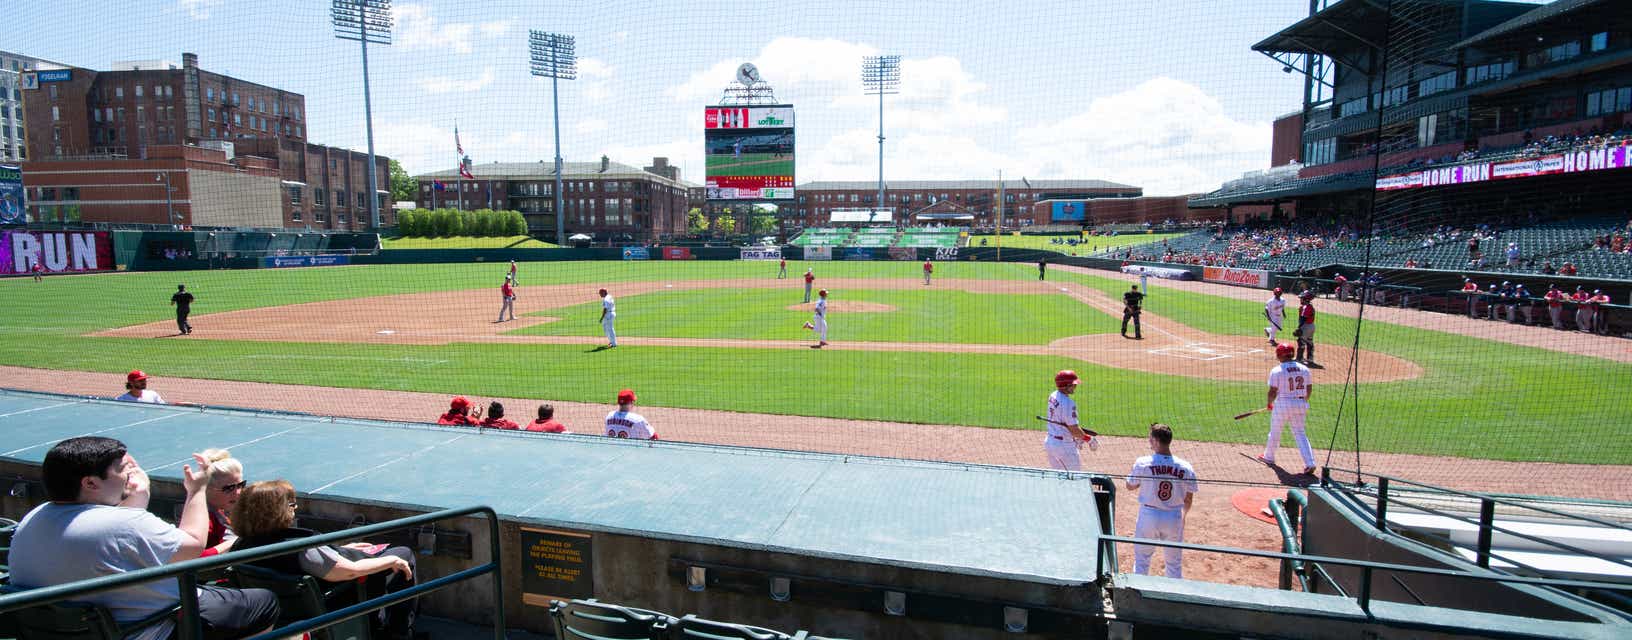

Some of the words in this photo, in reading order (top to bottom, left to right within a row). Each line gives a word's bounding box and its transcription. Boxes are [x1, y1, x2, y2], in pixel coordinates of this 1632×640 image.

[1564, 147, 1617, 172] HOME
[1423, 167, 1457, 186] HOME
[1463, 164, 1490, 183] RUN
[12, 232, 98, 272] RUN
[1224, 269, 1260, 285] AutoZone
[1288, 376, 1305, 392] 12
[1149, 465, 1186, 479] THOMAS
[1158, 481, 1173, 502] 8
[531, 545, 555, 553] OBJECTS
[540, 539, 562, 547] BEWARE
[541, 553, 565, 561] PLAYING
[535, 565, 555, 573] PLEASE
